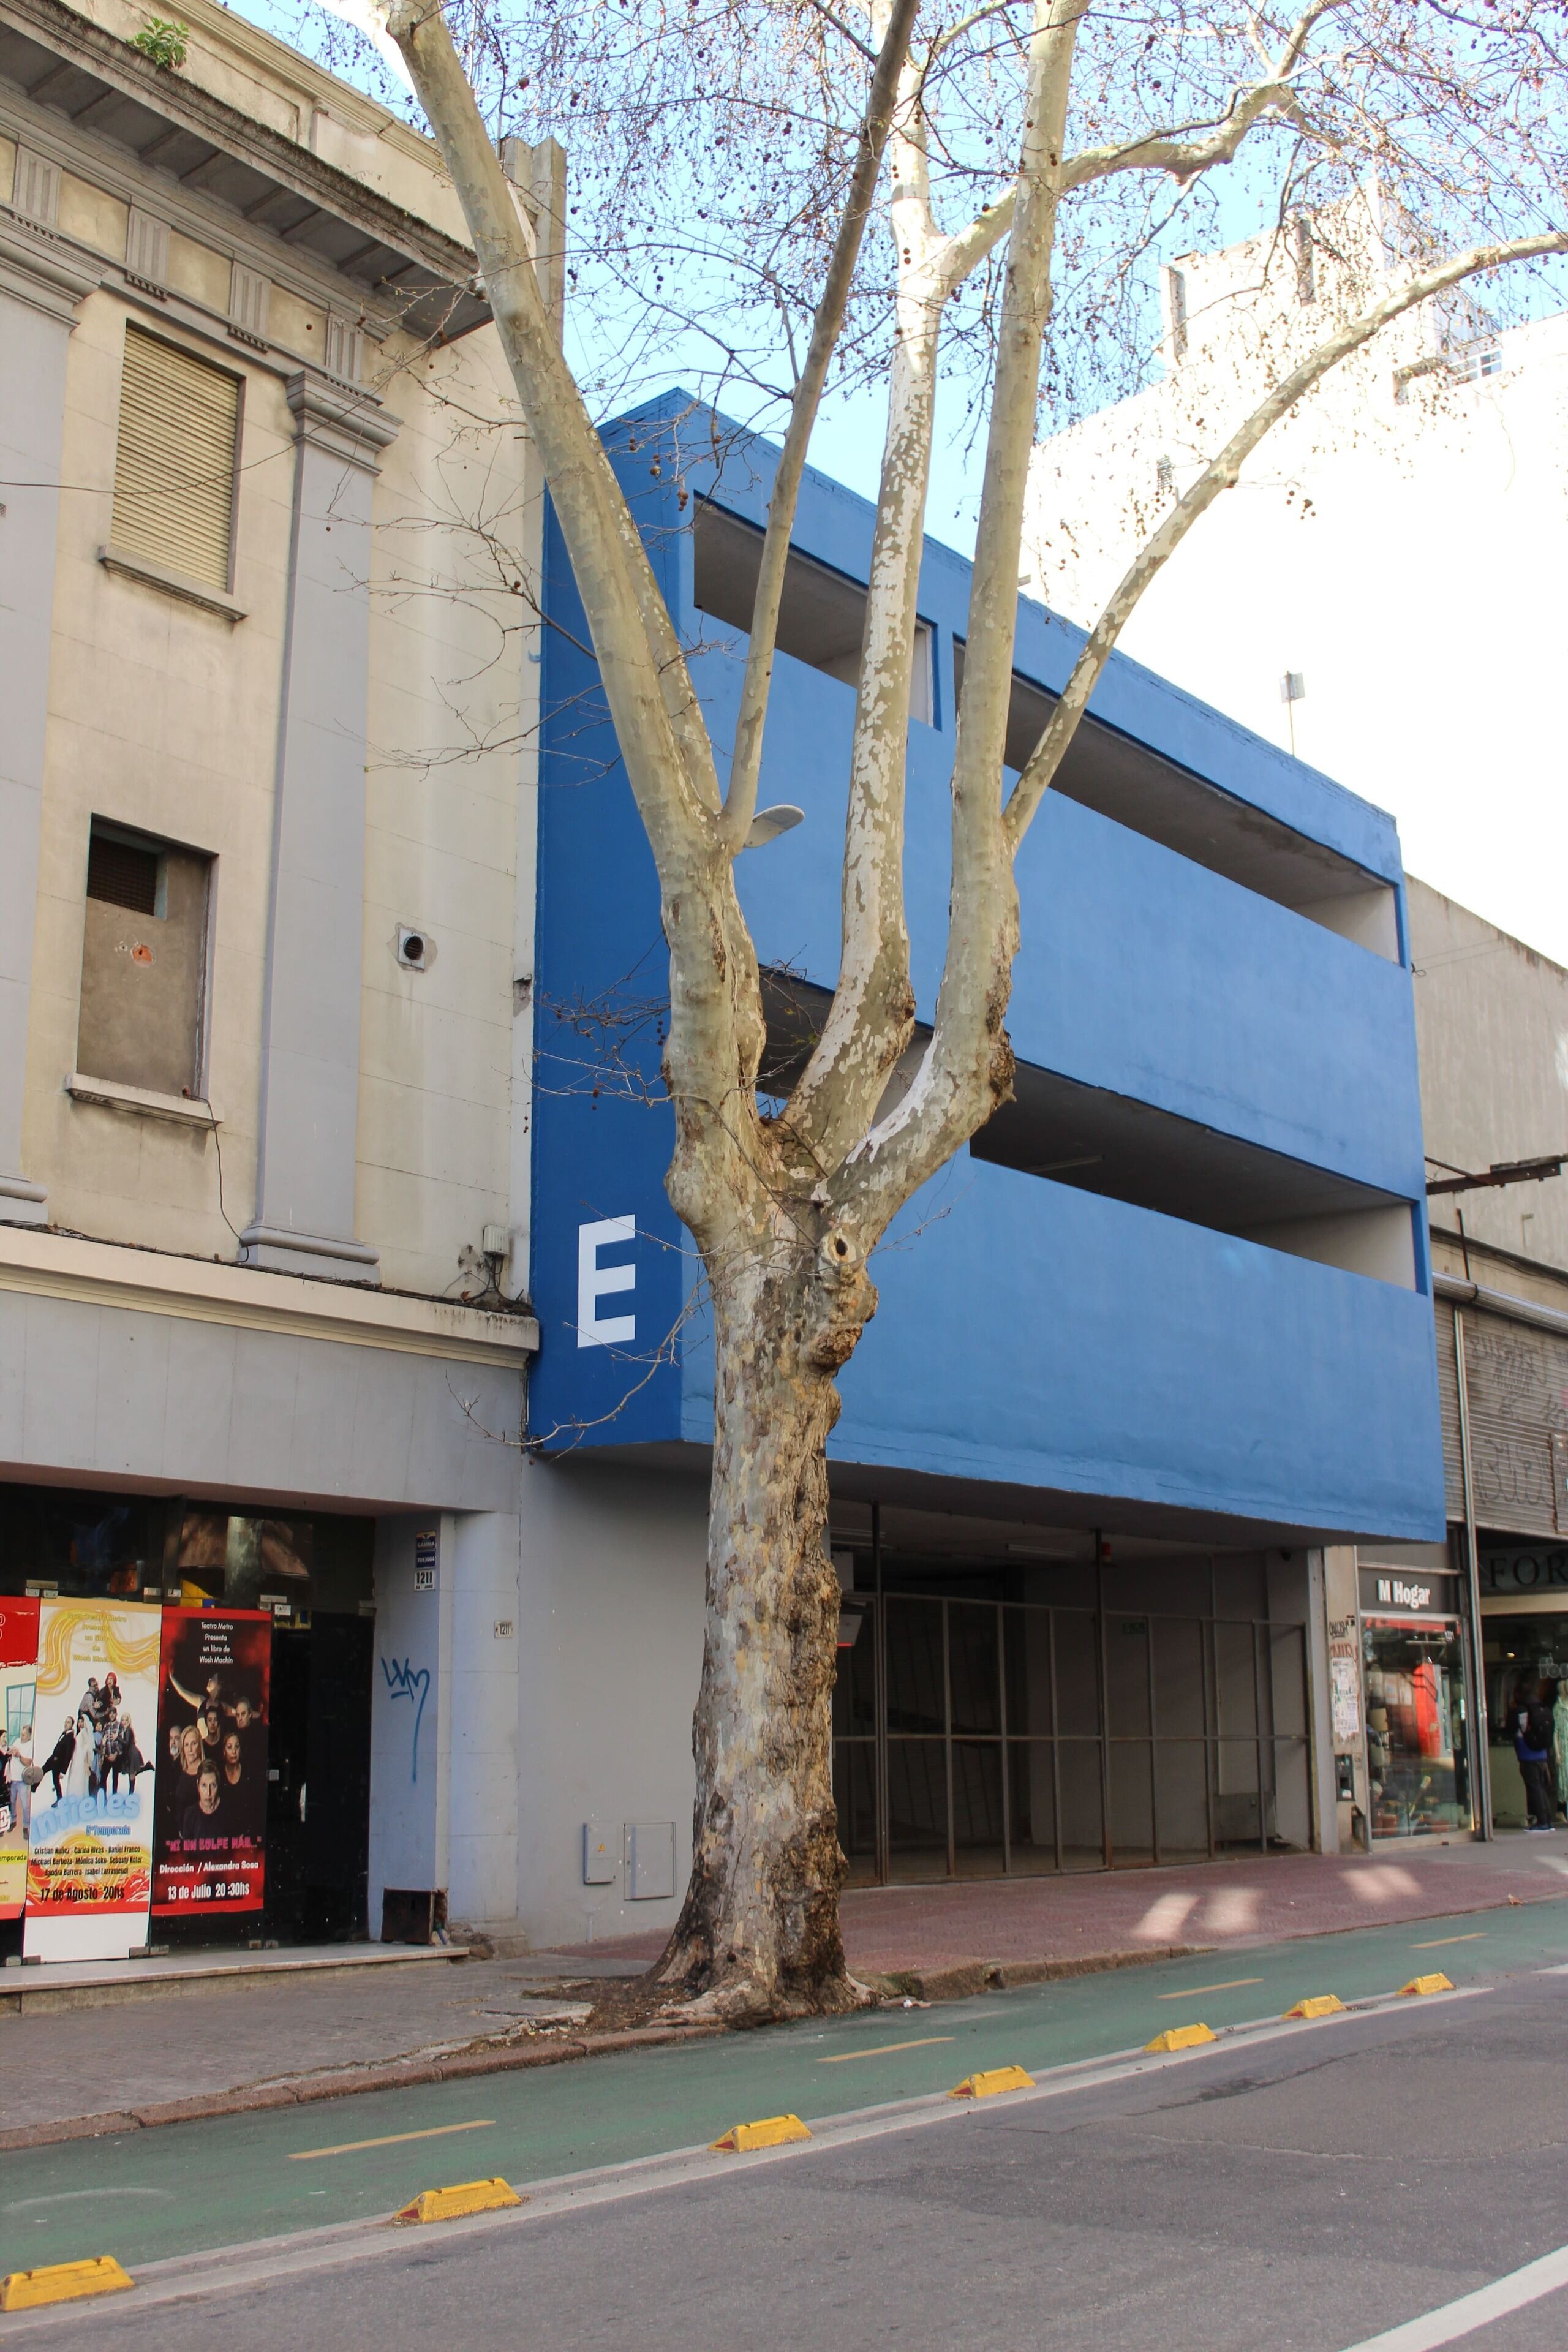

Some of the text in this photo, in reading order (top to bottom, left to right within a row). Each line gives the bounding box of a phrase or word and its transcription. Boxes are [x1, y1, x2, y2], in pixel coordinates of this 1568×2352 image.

[578, 1214, 635, 1348] E
[417, 1571, 432, 1584] 1211
[1378, 1579, 1430, 1609] M Hogar
[500, 1623, 509, 1635] 1211
[210, 1644, 222, 1653] libro
[108, 1844, 123, 1853] Daniel
[159, 1863, 194, 1874] Dirección
[203, 1860, 240, 1871] Alexandra
[241, 1860, 259, 1869] Sosa
[40, 1885, 125, 1902] 17 de Agosto 20hs
[168, 1886, 177, 1900] 13
[179, 1885, 189, 1899] de
[191, 1883, 211, 1899] Julio
